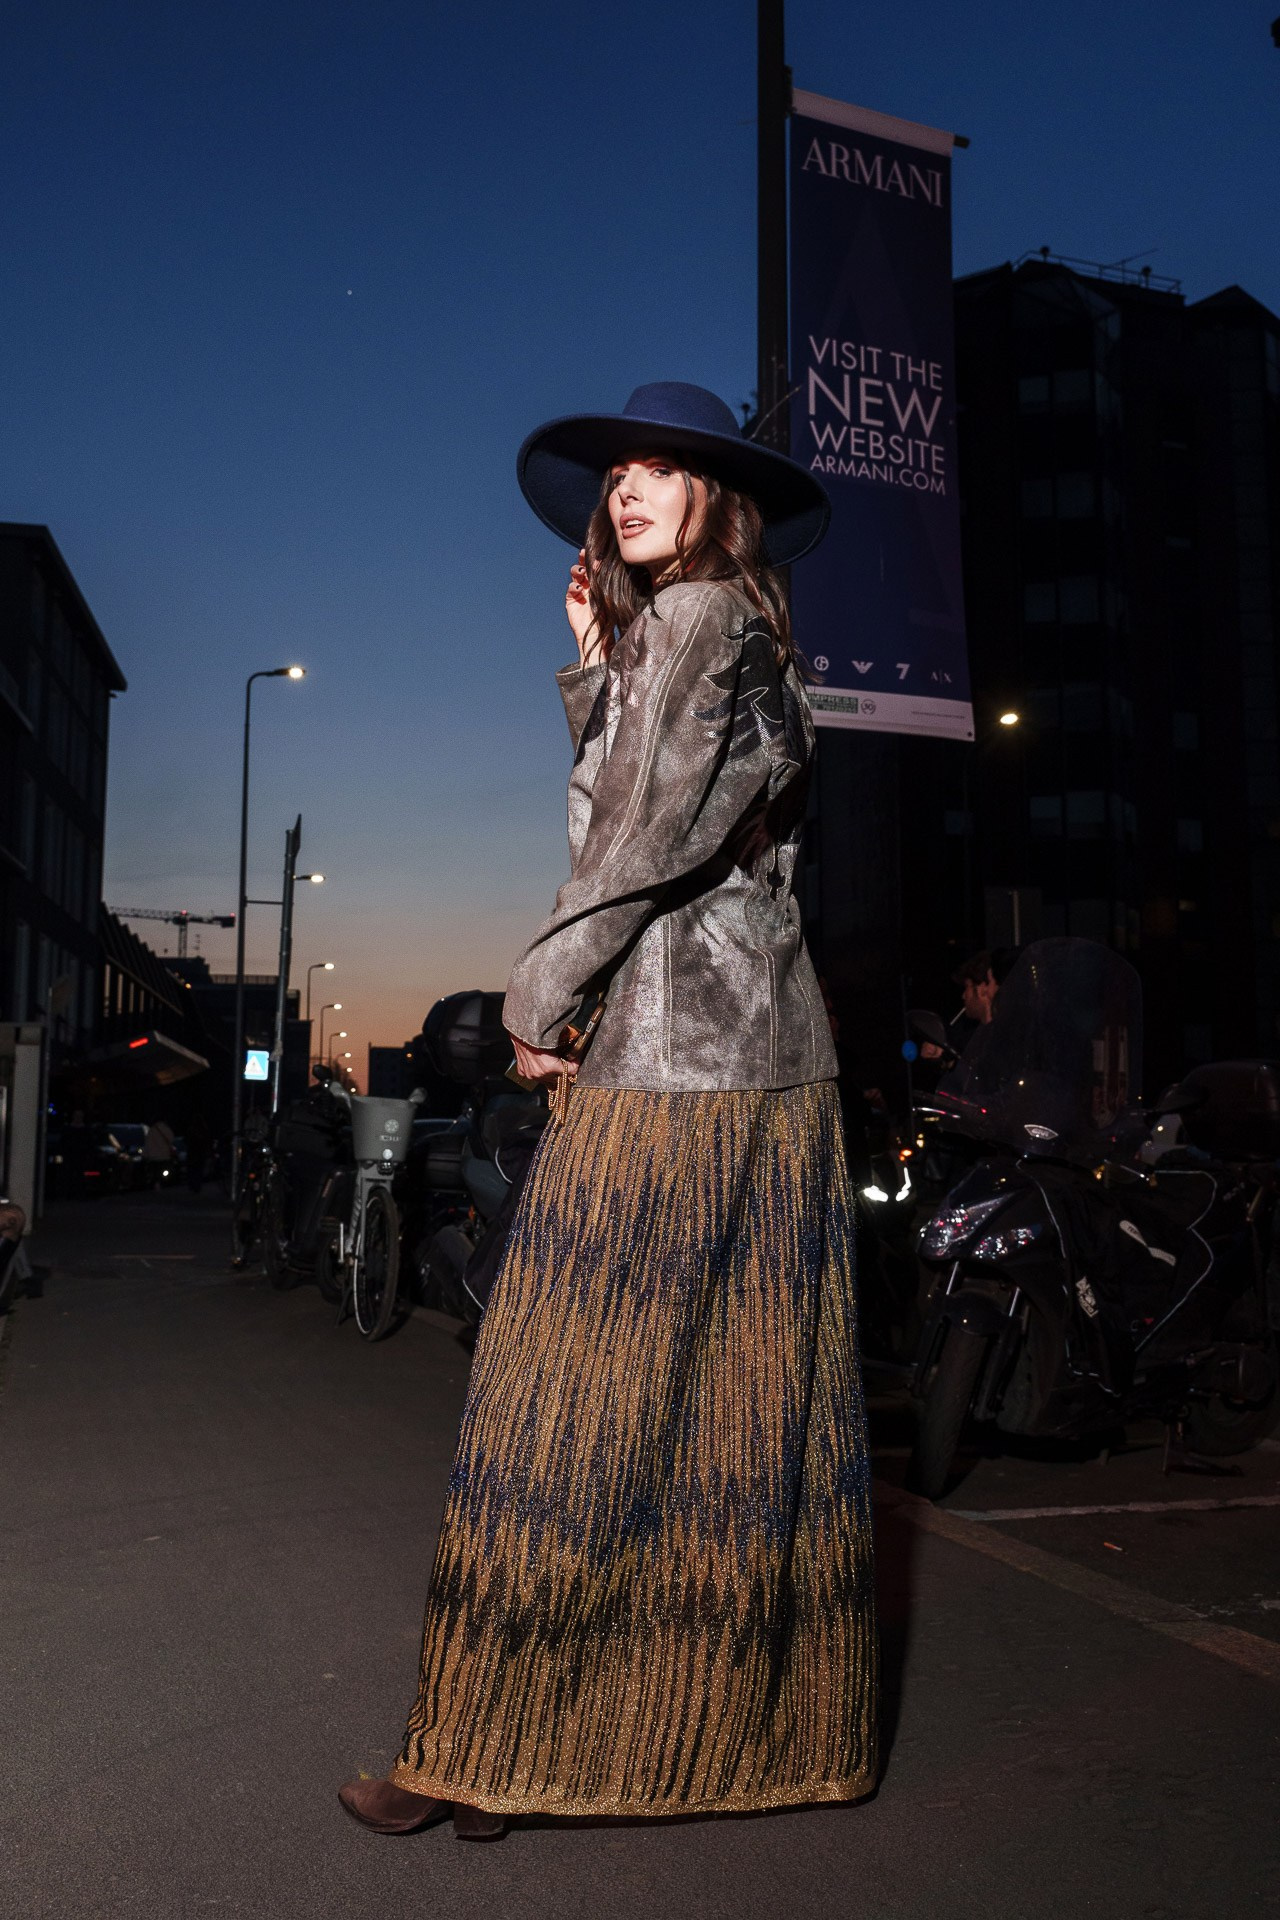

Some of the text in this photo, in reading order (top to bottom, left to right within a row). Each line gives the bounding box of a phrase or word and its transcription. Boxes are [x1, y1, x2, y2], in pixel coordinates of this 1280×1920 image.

[801, 136, 944, 208] ARMANI
[808, 335, 944, 392] VISIT THE
[808, 366, 944, 440] NEW
[809, 420, 946, 477] WEBSITE
[809, 453, 947, 496] ARMANI.COM
[895, 663, 911, 681] 7
